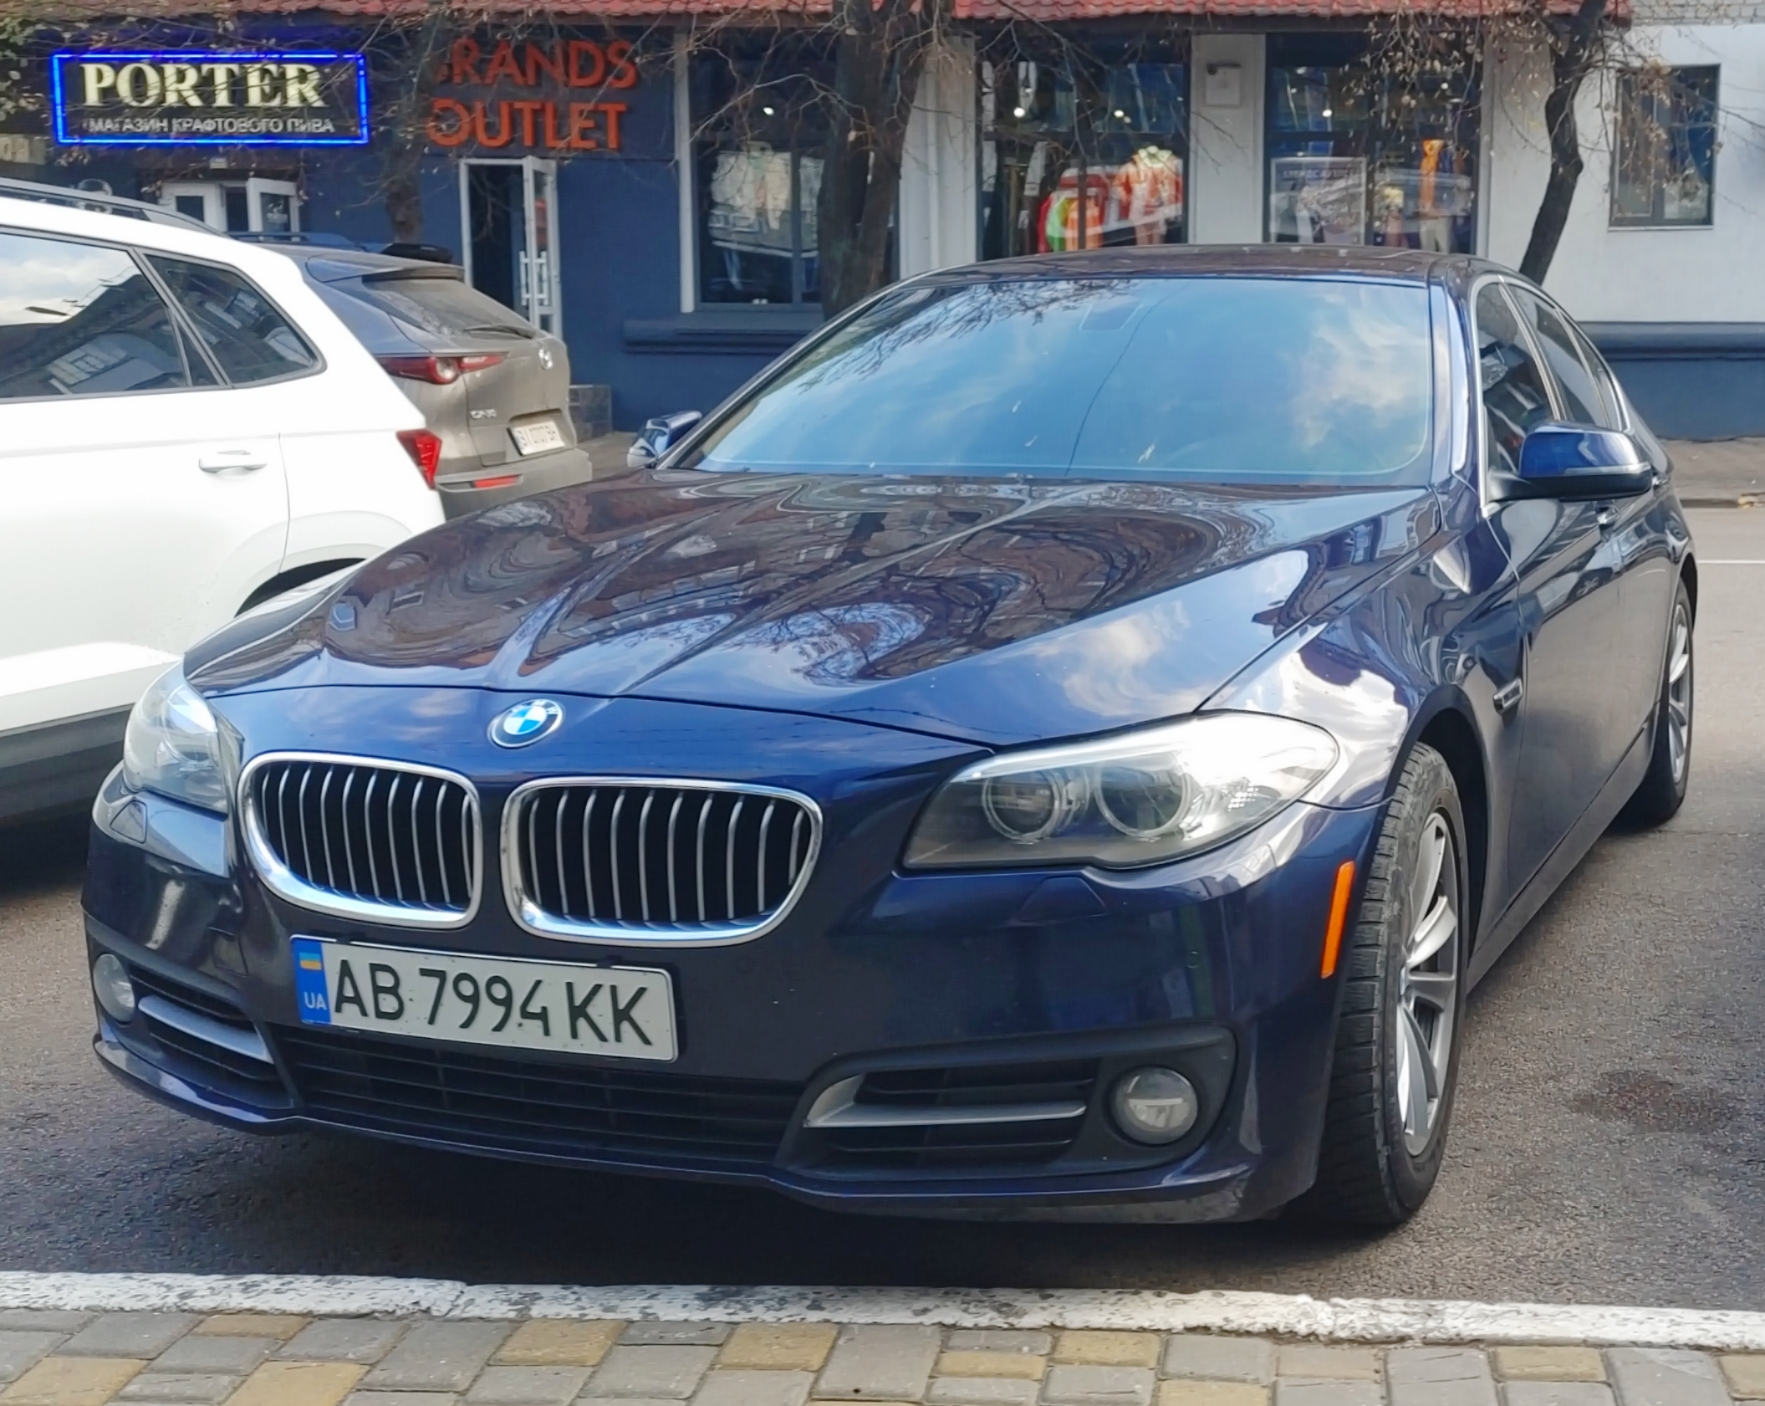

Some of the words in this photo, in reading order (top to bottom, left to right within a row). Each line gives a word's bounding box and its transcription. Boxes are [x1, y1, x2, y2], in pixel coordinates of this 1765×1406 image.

[80, 62, 326, 108] PORTER
[172, 117, 284, 133] КРАФТОВОГО
[426, 97, 627, 149] OUTLET
[303, 991, 327, 1011] UA
[335, 959, 404, 1020] AB
[419, 968, 550, 1036] 7994
[566, 981, 653, 1046] KK
